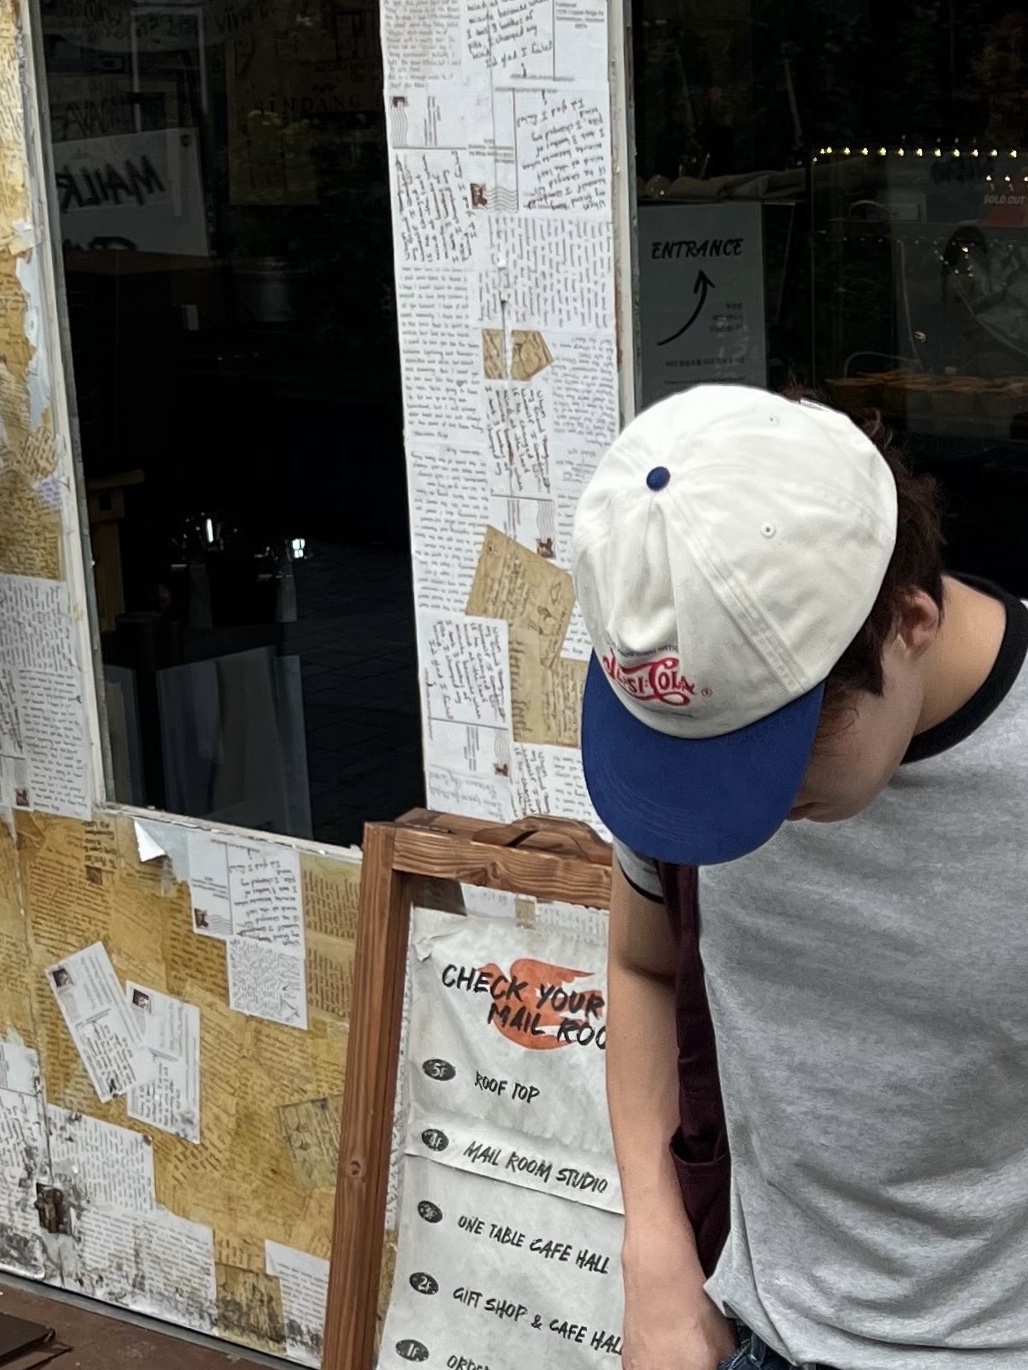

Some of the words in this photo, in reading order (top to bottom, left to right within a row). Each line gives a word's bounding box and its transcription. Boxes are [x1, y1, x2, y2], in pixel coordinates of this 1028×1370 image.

[652, 239, 744, 259] ENTRANCE
[442, 964, 528, 1002] CHECK
[536, 983, 605, 1020] YOUR
[488, 1002, 546, 1036] MAIL
[557, 1017, 606, 1050] ROO
[474, 1069, 508, 1096] ROOF
[511, 1082, 540, 1104] TOP
[463, 1141, 502, 1167] MAIL
[505, 1152, 553, 1183] ROOM
[556, 1168, 609, 1193] STUDIO
[457, 1215, 486, 1235] ONE
[489, 1224, 526, 1248] TABLE
[530, 1238, 573, 1262] CAFE
[576, 1249, 610, 1274] HALL
[453, 1287, 483, 1309] GIFT
[484, 1298, 528, 1321] SHOP
[531, 1314, 543, 1330] &
[549, 1318, 588, 1343] CAFE
[590, 1330, 624, 1356] HAL
